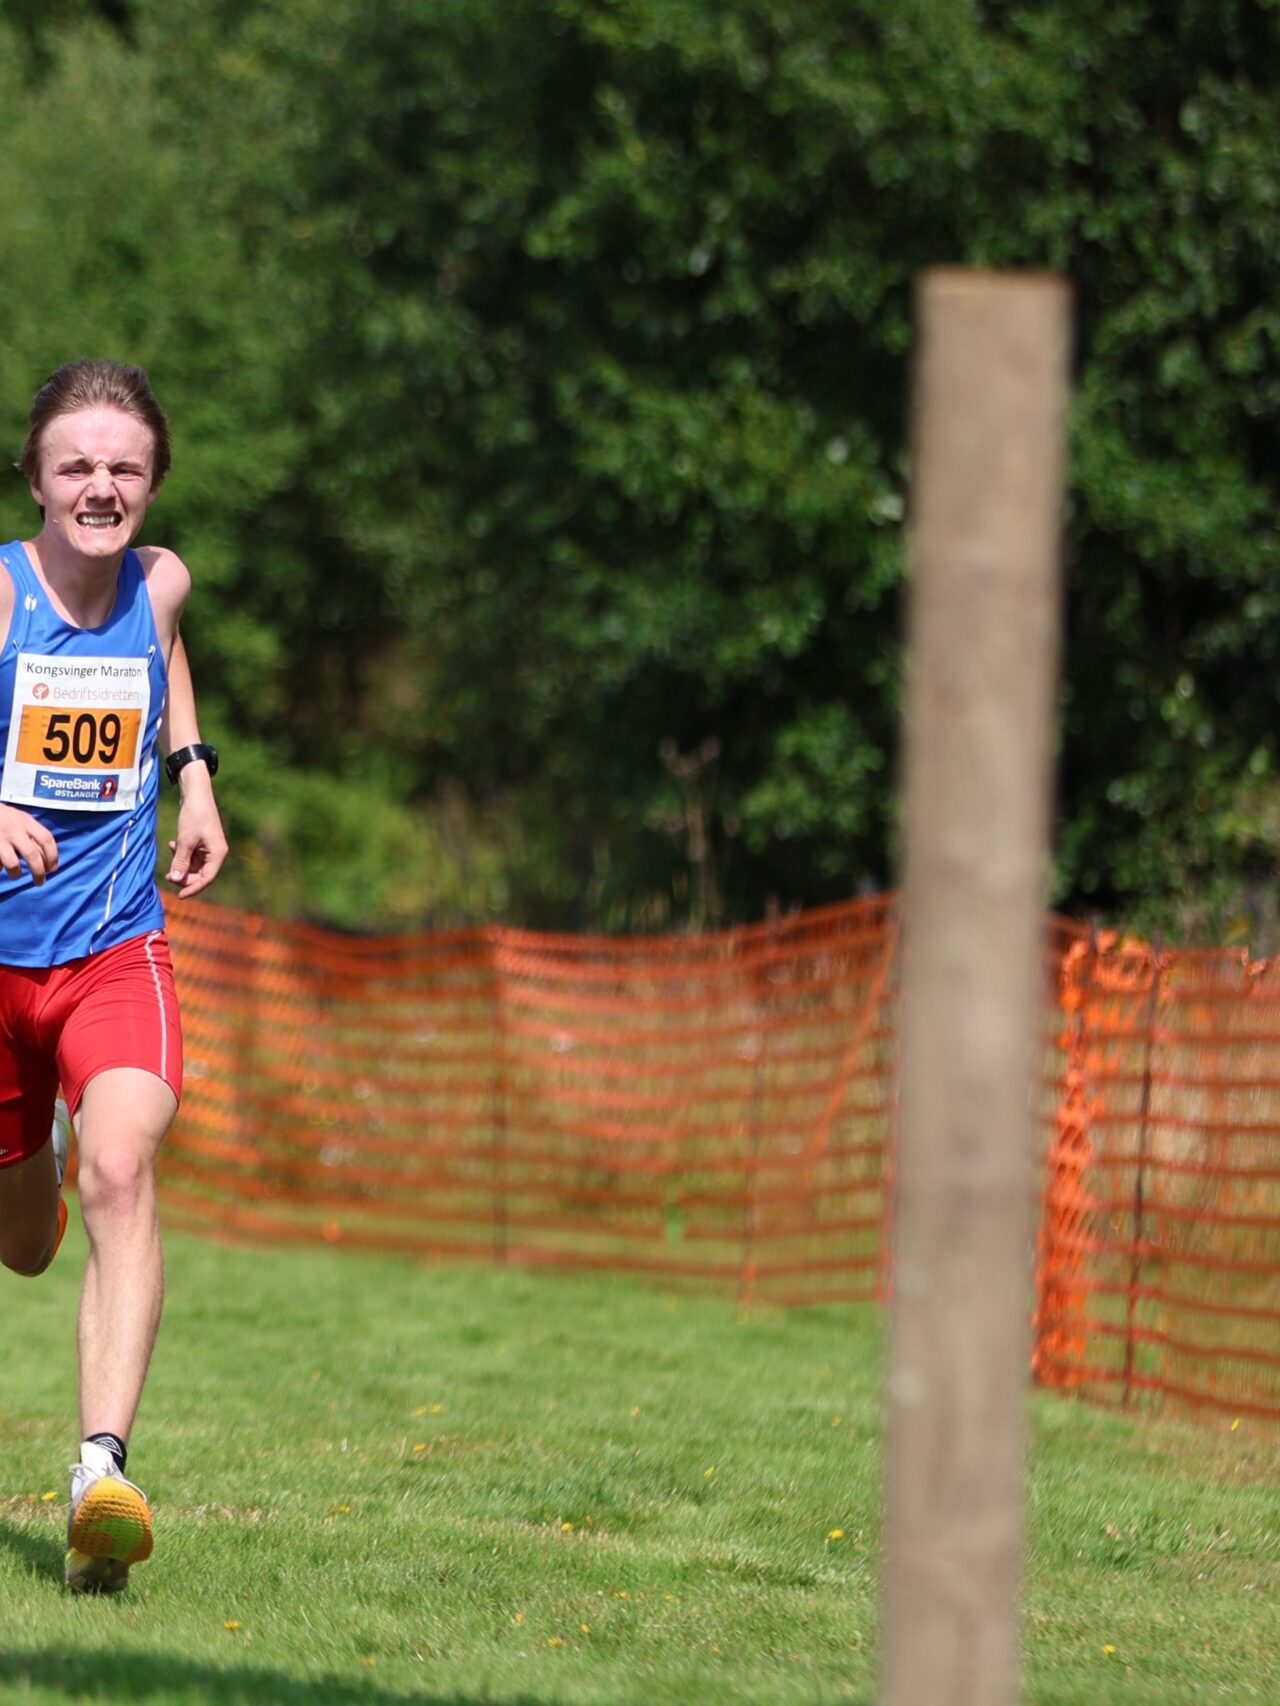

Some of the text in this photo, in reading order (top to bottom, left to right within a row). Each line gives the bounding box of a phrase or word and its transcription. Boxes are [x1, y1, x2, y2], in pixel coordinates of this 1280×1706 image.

[26, 662, 142, 678] Kongsvinger Maraton
[53, 687, 139, 701] Bedriftsidretten
[43, 713, 121, 764] 509
[40, 775, 100, 790] SpareBank
